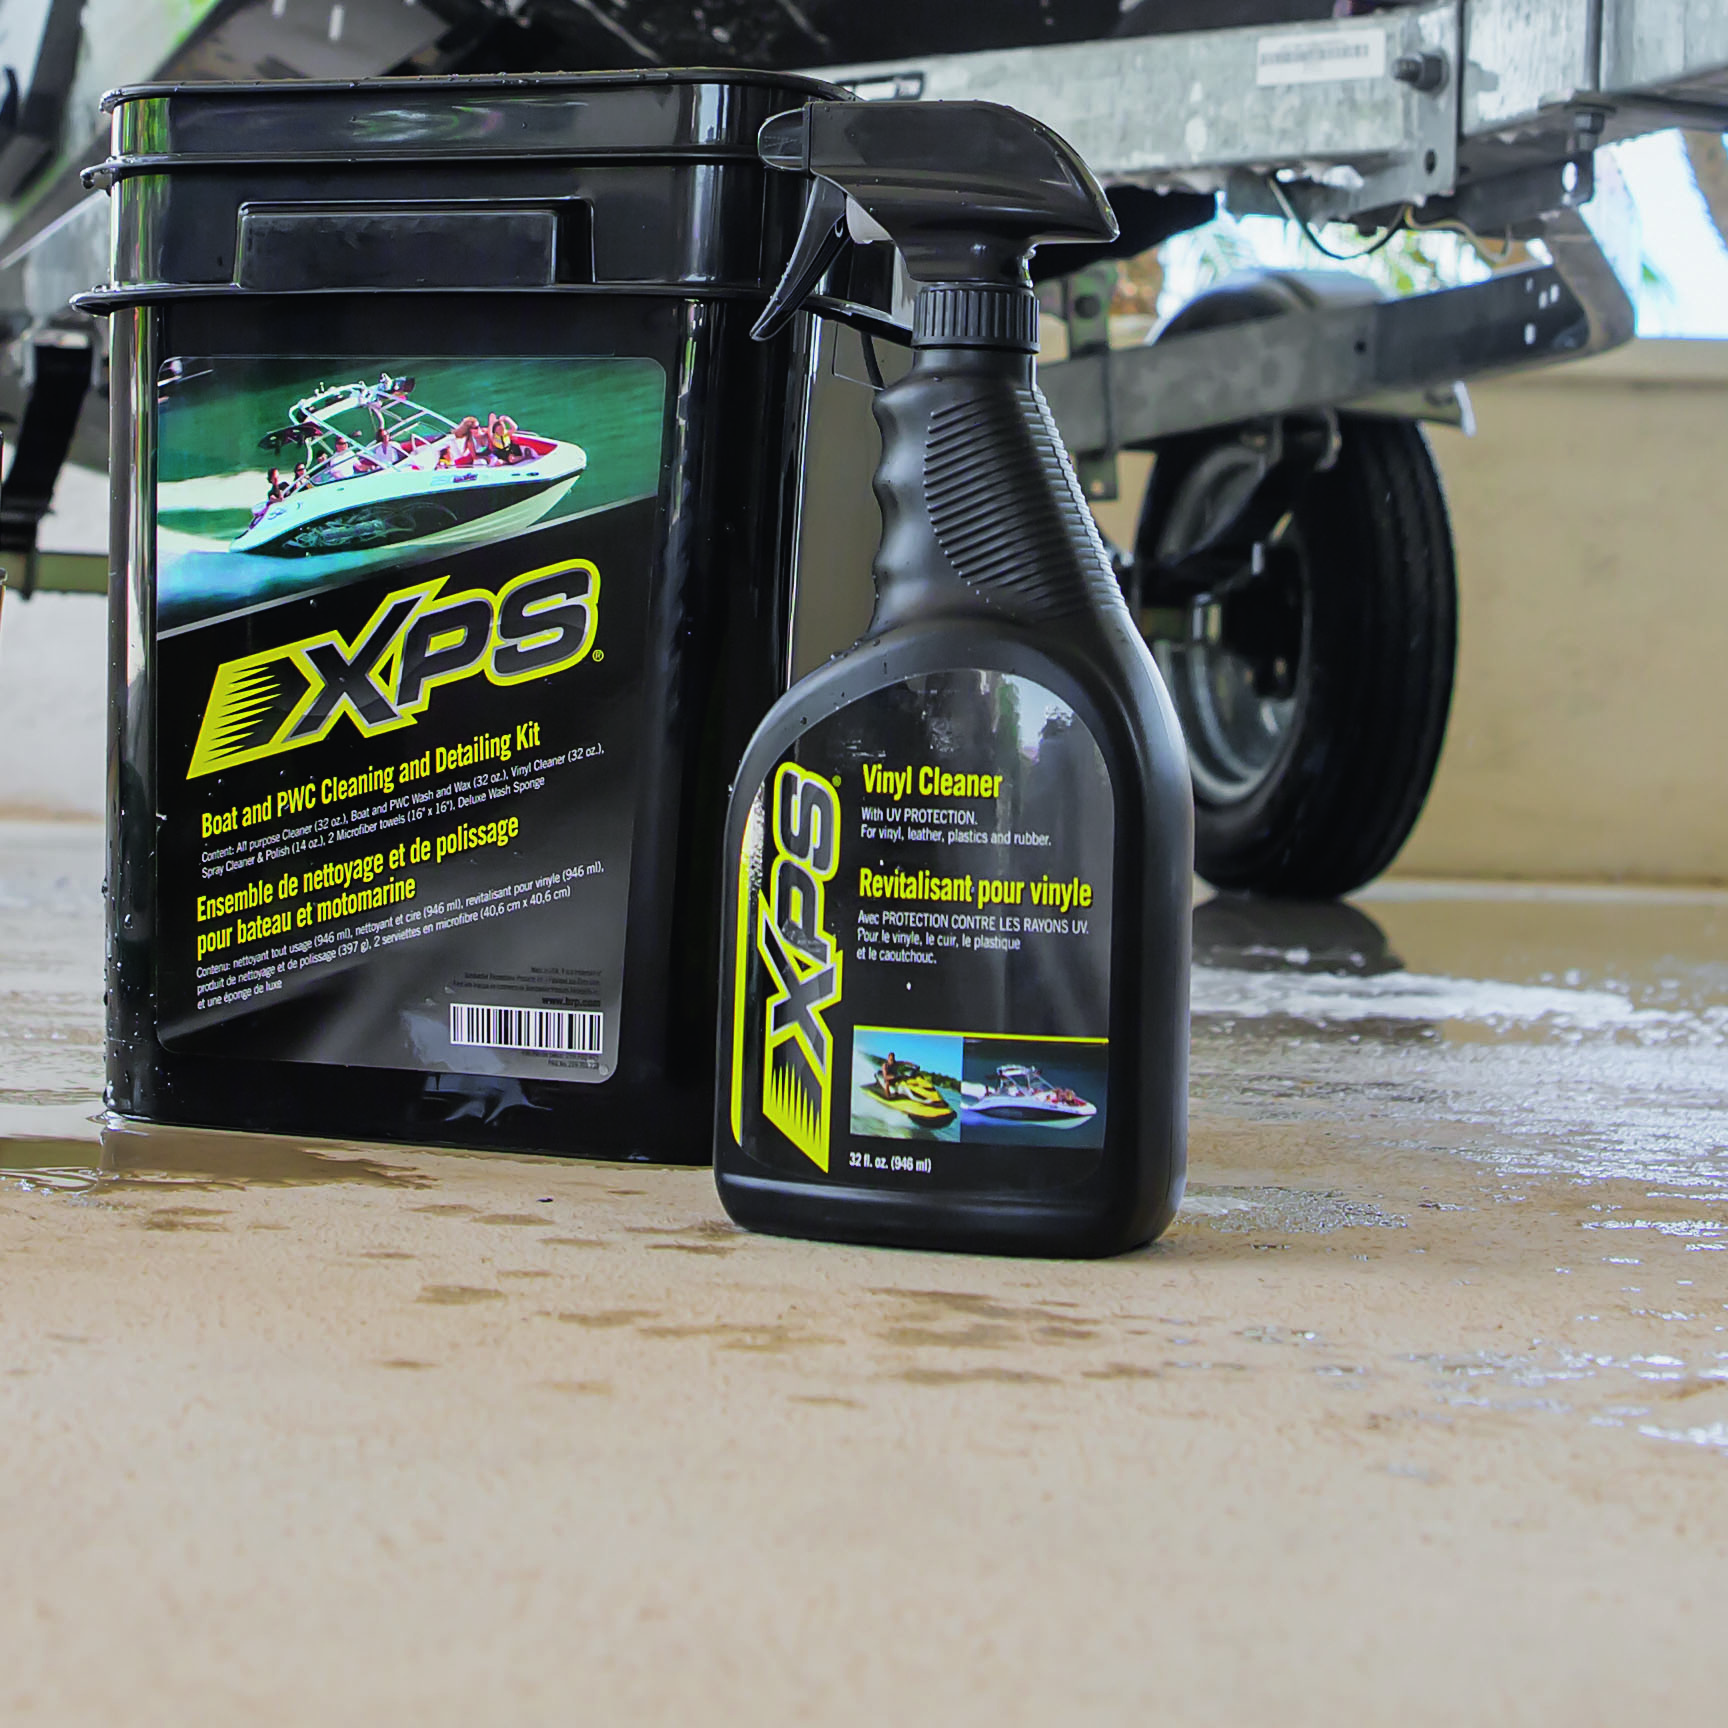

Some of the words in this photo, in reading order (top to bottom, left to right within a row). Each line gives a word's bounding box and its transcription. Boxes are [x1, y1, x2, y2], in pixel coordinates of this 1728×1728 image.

[270, 557, 601, 747] XPS
[202, 811, 237, 839] Boat
[242, 796, 271, 827] and
[277, 785, 315, 819] PWC
[321, 765, 394, 805] Cleaning
[401, 752, 430, 790] and
[435, 733, 511, 774] Detailing
[516, 722, 540, 753] Kit
[863, 764, 912, 801] Vinyl
[919, 766, 1003, 798] Cleaner
[861, 807, 883, 821] With
[886, 809, 901, 822] UV
[904, 809, 978, 825] PROTECTION.
[861, 825, 875, 837] For
[879, 827, 904, 843] vinyl,
[908, 828, 944, 843] leather,
[948, 829, 988, 845] plastics
[991, 832, 1011, 844] and
[1014, 833, 1051, 846] rubber.
[197, 884, 272, 922] Ensemble
[278, 872, 298, 899] de
[303, 853, 383, 893] nettoyage
[389, 845, 405, 870] et
[410, 838, 431, 864] de
[436, 815, 519, 857] polissage
[859, 868, 972, 902] Revitalisant
[977, 879, 1025, 909] pour
[1030, 875, 1092, 913] vinyle
[197, 930, 233, 960] pour
[238, 911, 291, 946] bateau
[296, 907, 313, 928] et
[317, 877, 416, 922] motomarine
[758, 761, 842, 1076] XPS
[858, 910, 879, 925] Avec
[882, 911, 948, 928] PROTECTION
[951, 915, 996, 930] CONTRE
[1000, 917, 1020, 931] LES
[1024, 918, 1068, 933] RAYONS
[1072, 920, 1089, 934] UV.
[857, 948, 866, 960] et
[869, 949, 877, 961] le
[880, 949, 936, 964] caoutchouc.
[858, 928, 878, 942] Pour
[882, 930, 890, 943] le
[892, 931, 922, 947] vinyle,
[926, 933, 934, 945] le
[937, 933, 958, 948] cuir,
[962, 934, 971, 947] le
[974, 935, 1020, 951] plastique
[849, 1152, 861, 1167] 32
[864, 1152, 873, 1167] fl.
[875, 1155, 889, 1169] oz.
[891, 1155, 913, 1171] (946
[916, 1158, 931, 1173] ml)
